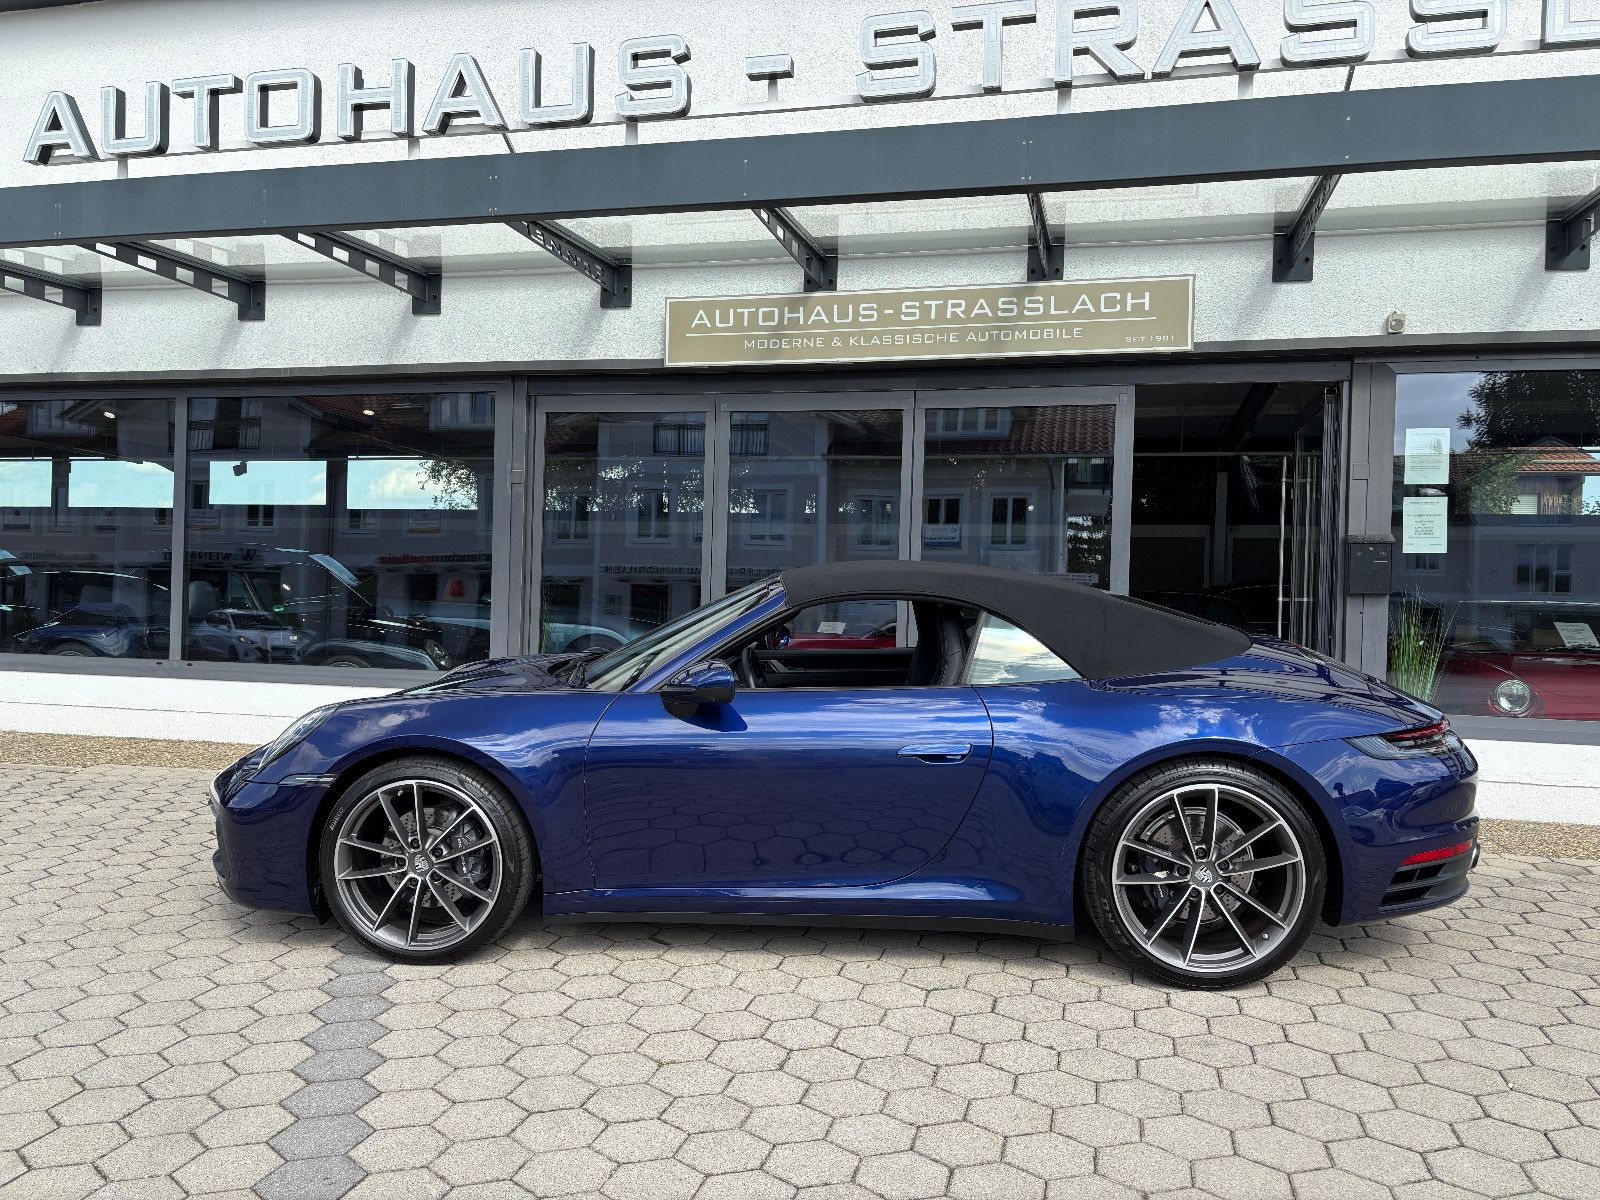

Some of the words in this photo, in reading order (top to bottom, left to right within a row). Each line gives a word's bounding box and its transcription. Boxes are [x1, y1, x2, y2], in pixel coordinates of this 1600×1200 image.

[23, 33, 692, 165] AUTOHAUS
[690, 291, 1151, 328] AUTOHAUS-STRASSLACH
[744, 336, 826, 350] MODERNE
[831, 336, 843, 348] &
[849, 331, 960, 347] KLASSISCHE
[965, 327, 1084, 343] AUTOMOBILE
